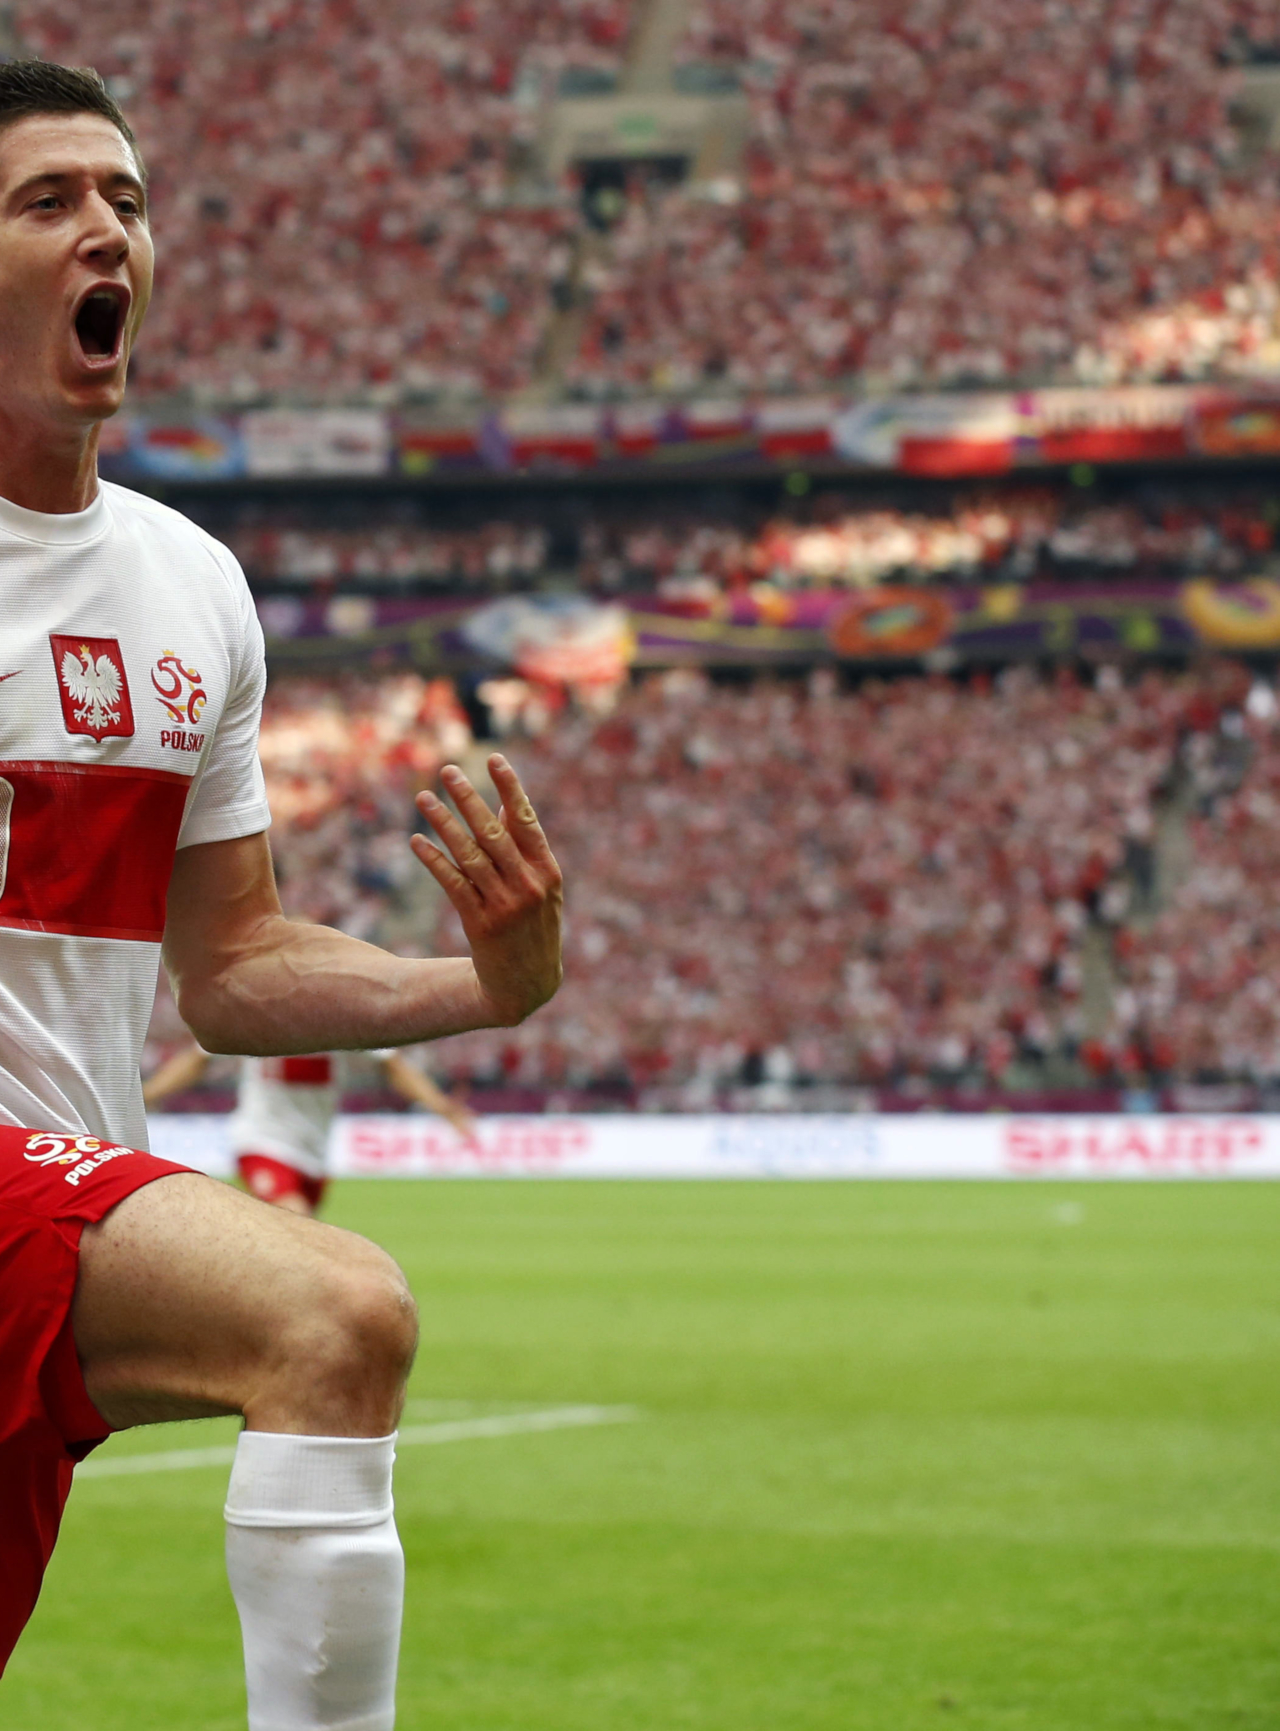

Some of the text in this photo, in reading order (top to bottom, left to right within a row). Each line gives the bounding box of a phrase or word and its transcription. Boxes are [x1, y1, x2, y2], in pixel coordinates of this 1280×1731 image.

[64, 1147, 135, 1187] POLSKA
[346, 1120, 590, 1172] SHARP
[1004, 1119, 1265, 1172] SHARP
